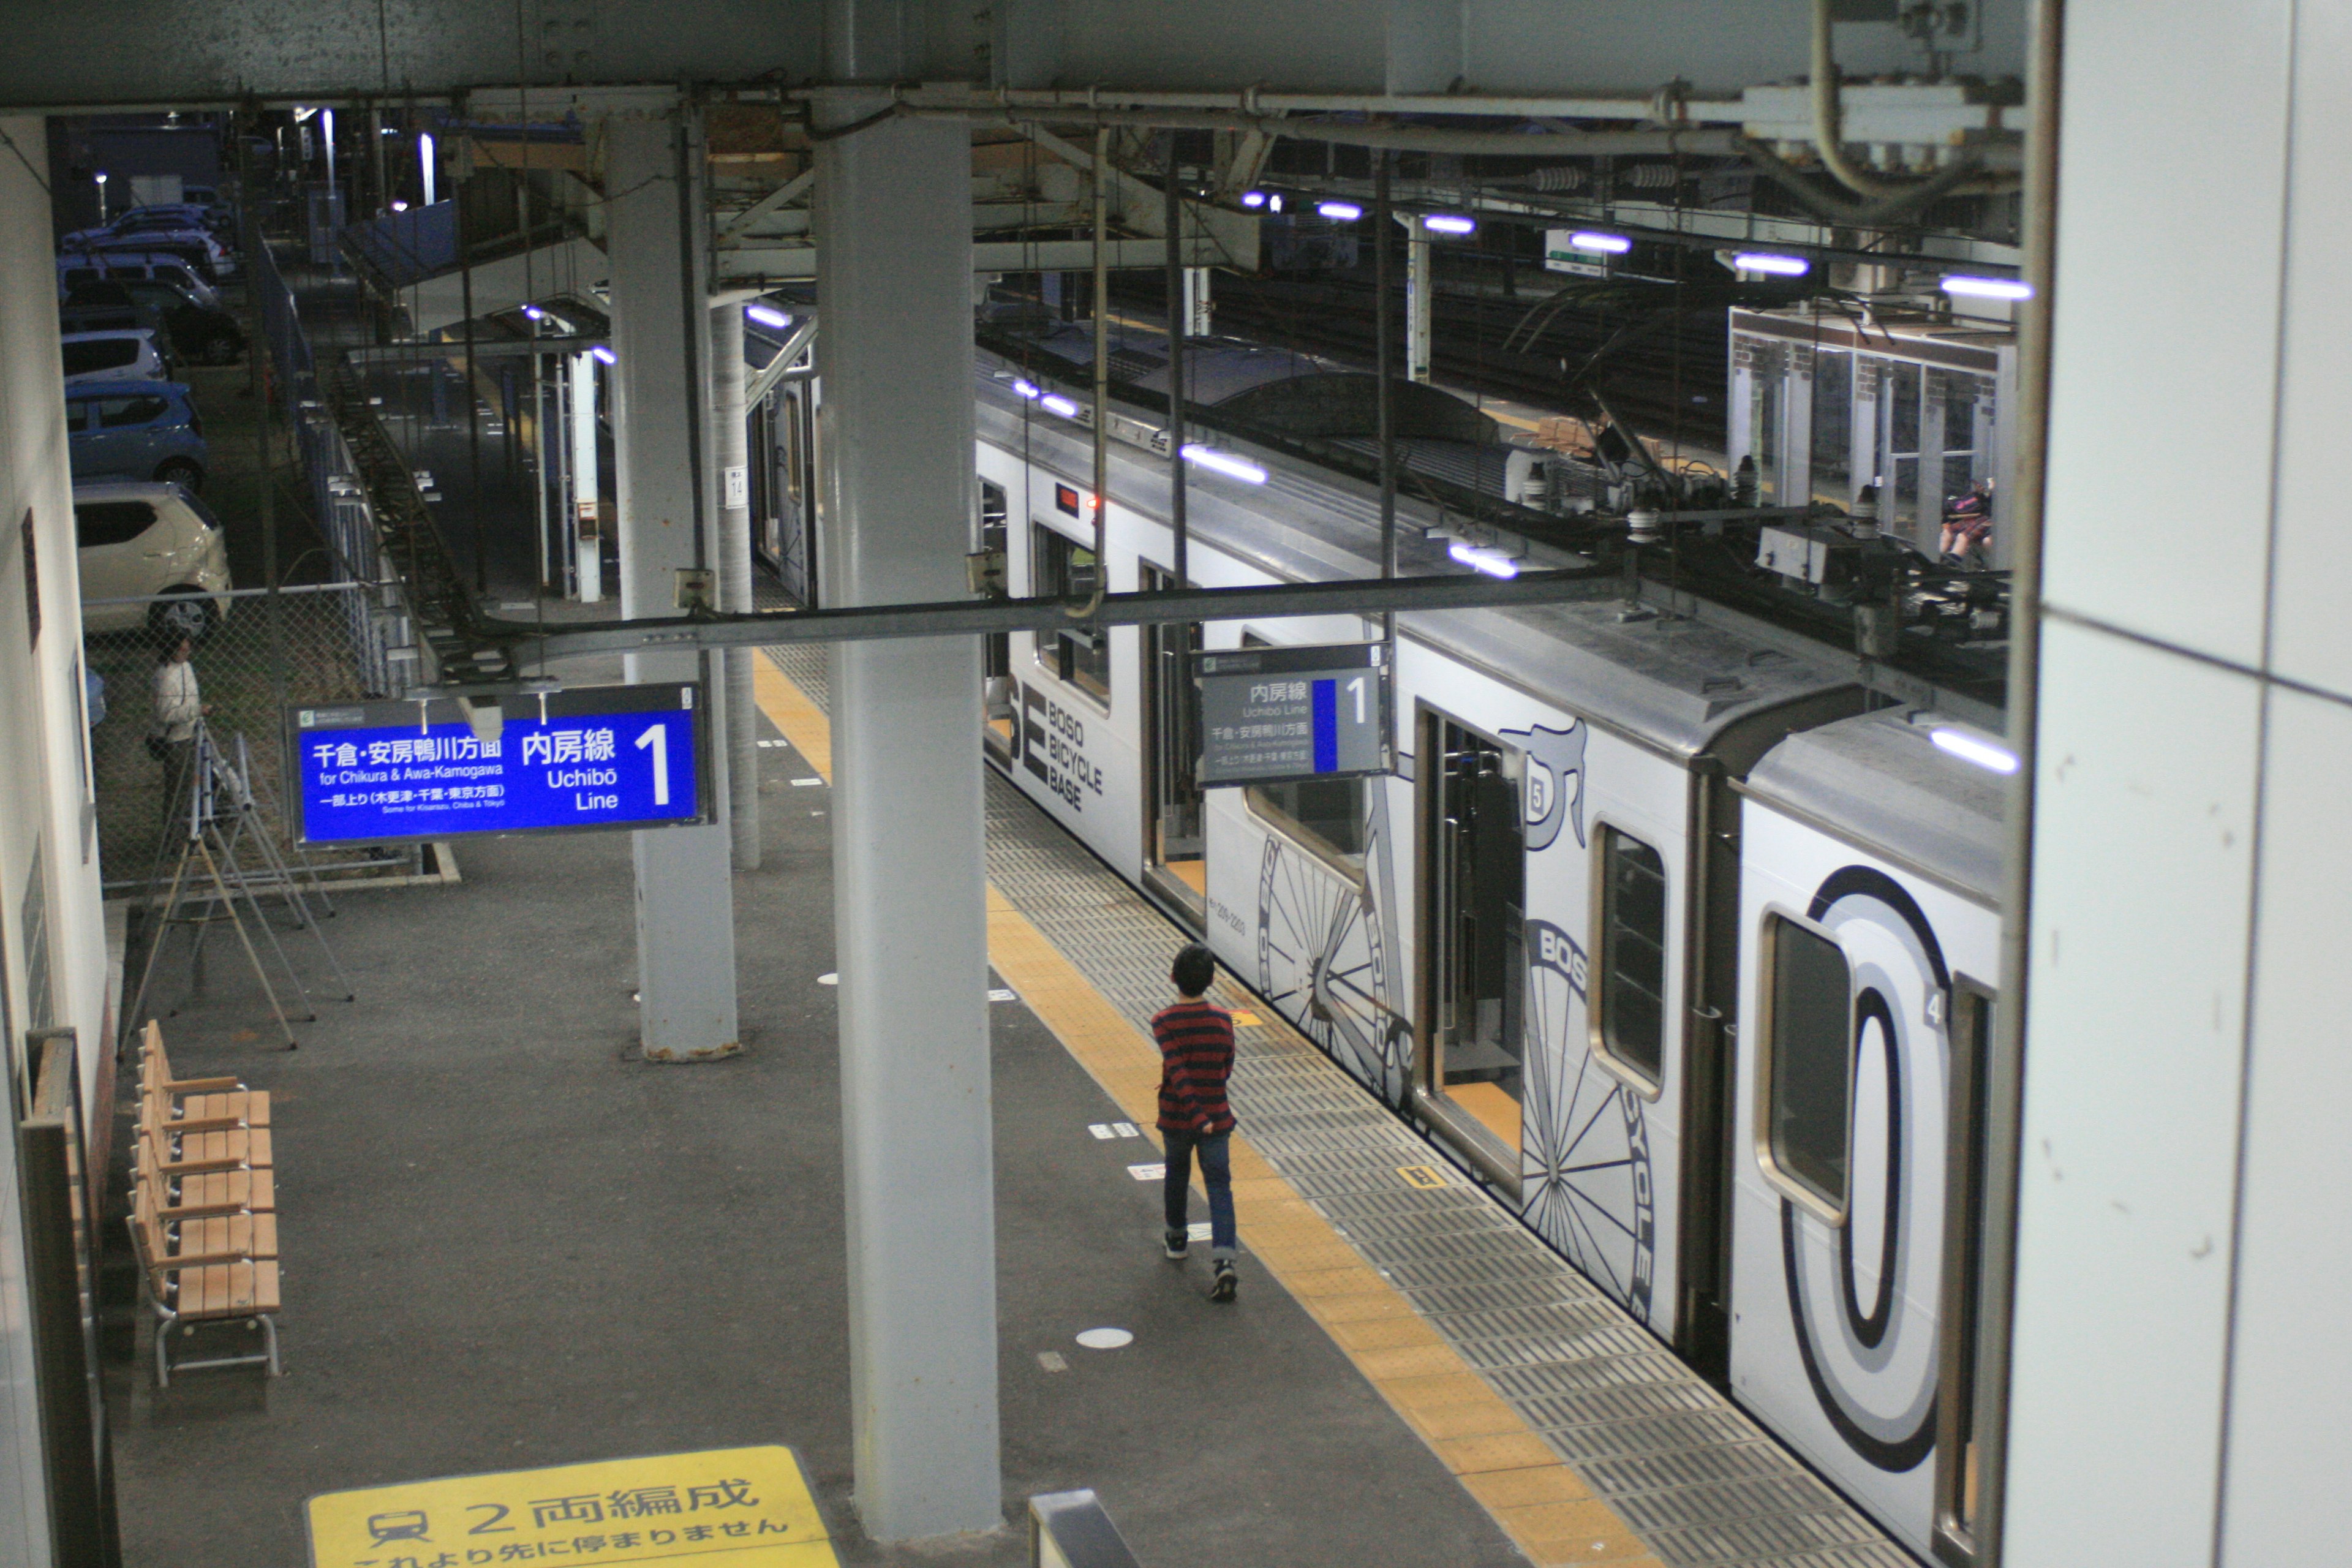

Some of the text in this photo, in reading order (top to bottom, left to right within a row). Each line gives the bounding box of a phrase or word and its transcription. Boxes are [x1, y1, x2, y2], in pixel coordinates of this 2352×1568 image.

[1250, 681, 1308, 703] 内房線
[1347, 677, 1365, 724] 1
[1049, 700, 1084, 748] BOSO
[1284, 705, 1308, 715] Line
[313, 737, 502, 768] 千倉・安房鴨川方面
[522, 729, 616, 766] 内房線
[320, 764, 503, 786] for Chikura & Awa-Kamogawa
[546, 768, 617, 789] Uchibō
[635, 724, 670, 806] 1
[1049, 733, 1102, 796] BICYCLE
[576, 792, 618, 812] Line
[1050, 766, 1082, 813] BASE
[1533, 783, 1542, 808] 5
[382, 805, 404, 813] Some
[1928, 993, 1940, 1025] 4
[466, 1478, 761, 1534] 2両編成
